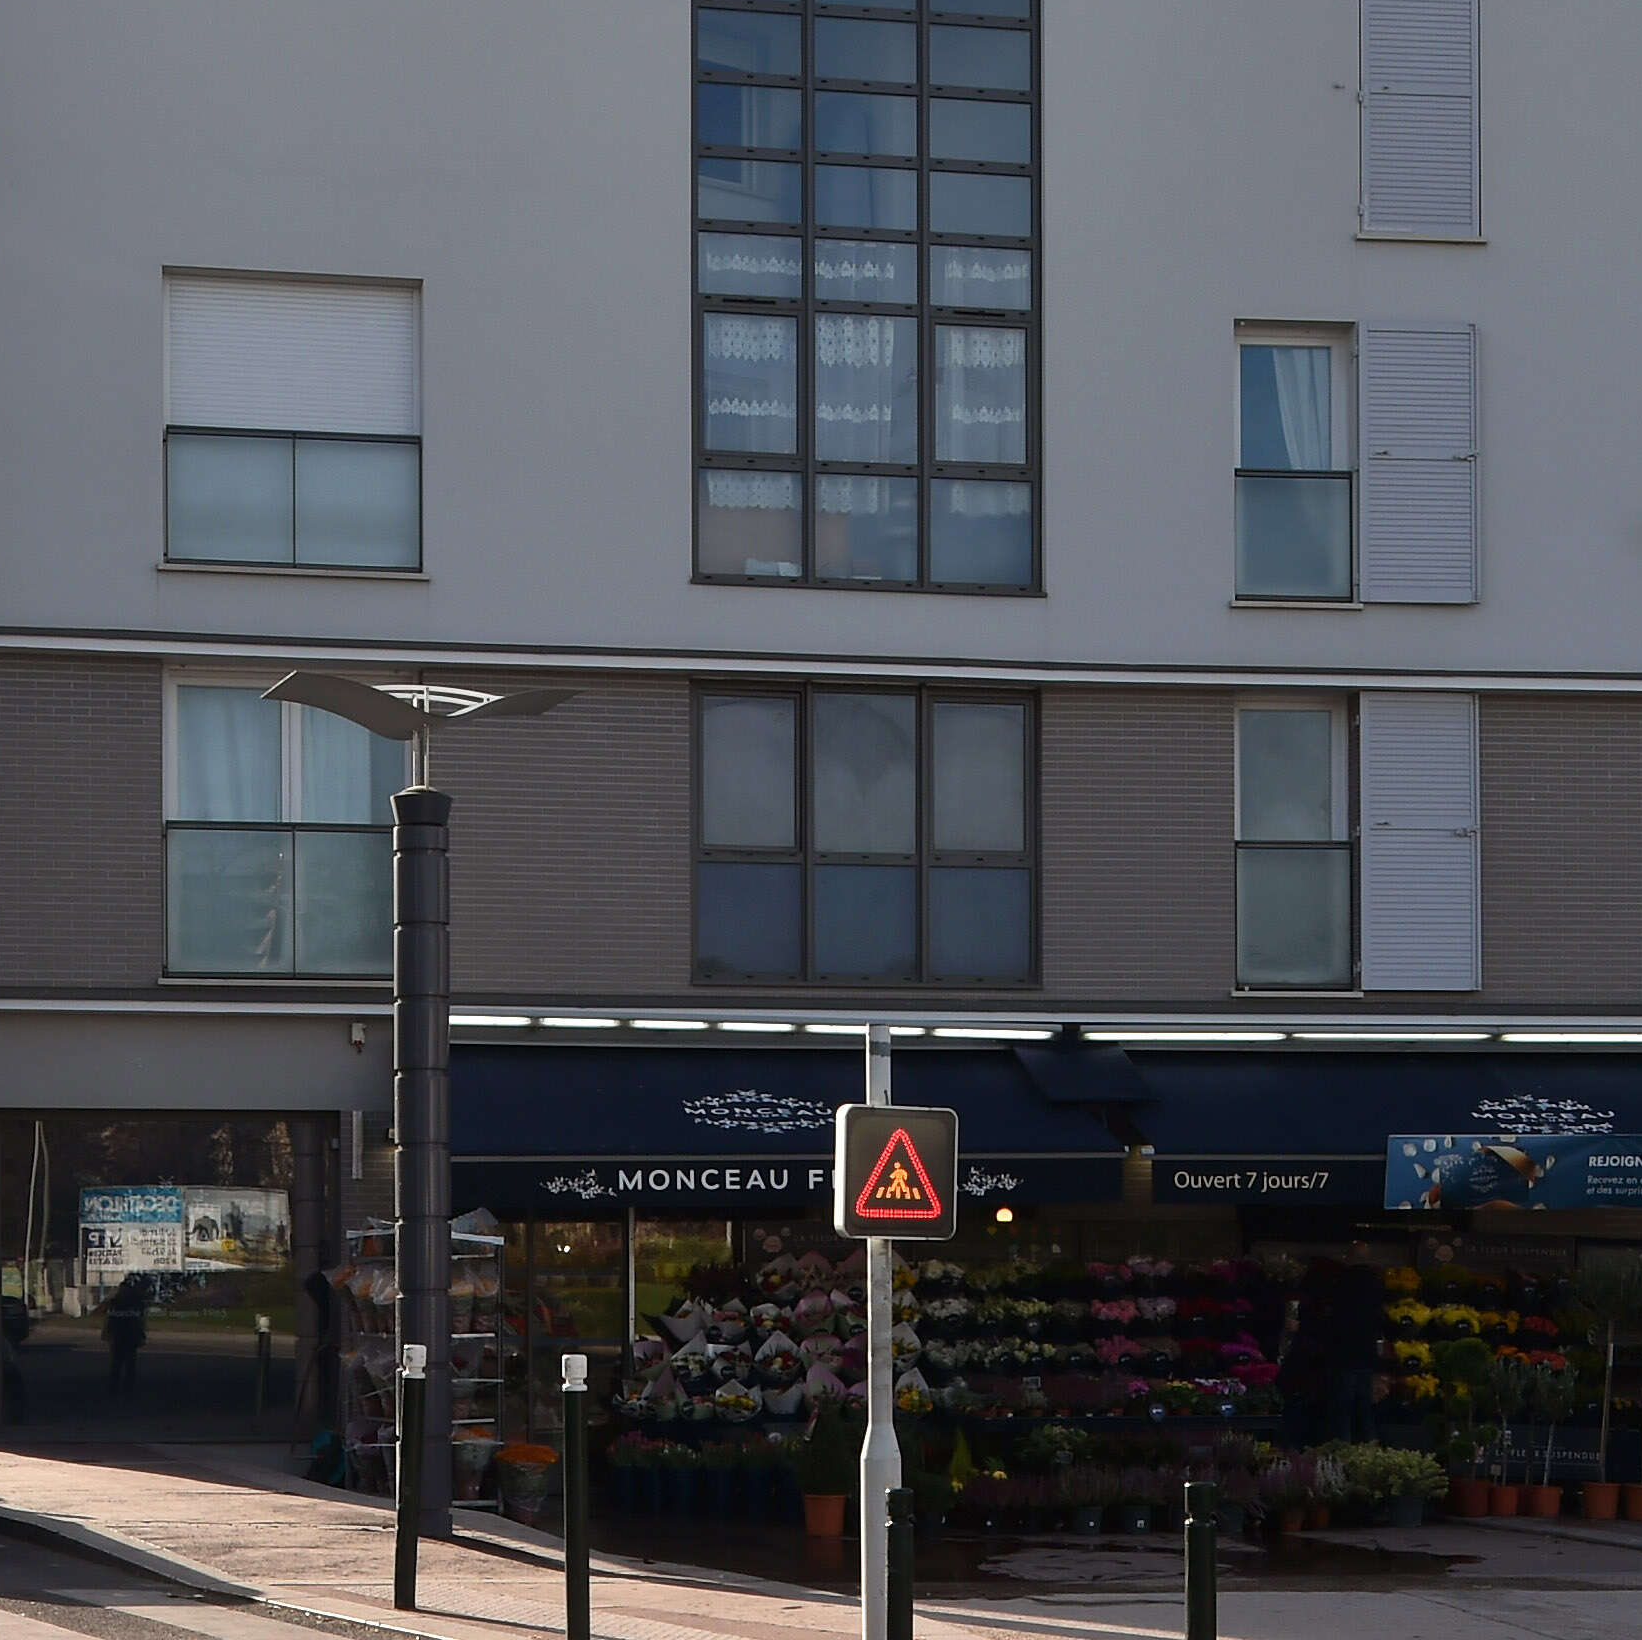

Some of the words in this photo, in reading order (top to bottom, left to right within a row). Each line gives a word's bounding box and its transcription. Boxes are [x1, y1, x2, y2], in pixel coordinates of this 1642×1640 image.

[684, 1107, 833, 1116] MONCEAU
[1470, 1110, 1615, 1120] MONCEAU
[618, 1168, 789, 1191] MONCEAU
[1173, 1170, 1241, 1189] Ouvert
[1246, 1171, 1257, 1189] 7
[1261, 1171, 1329, 1193] jours/7
[1587, 1175, 1624, 1185] Recevez
[1626, 1177, 1638, 1185] en
[1596, 1185, 1613, 1195] des
